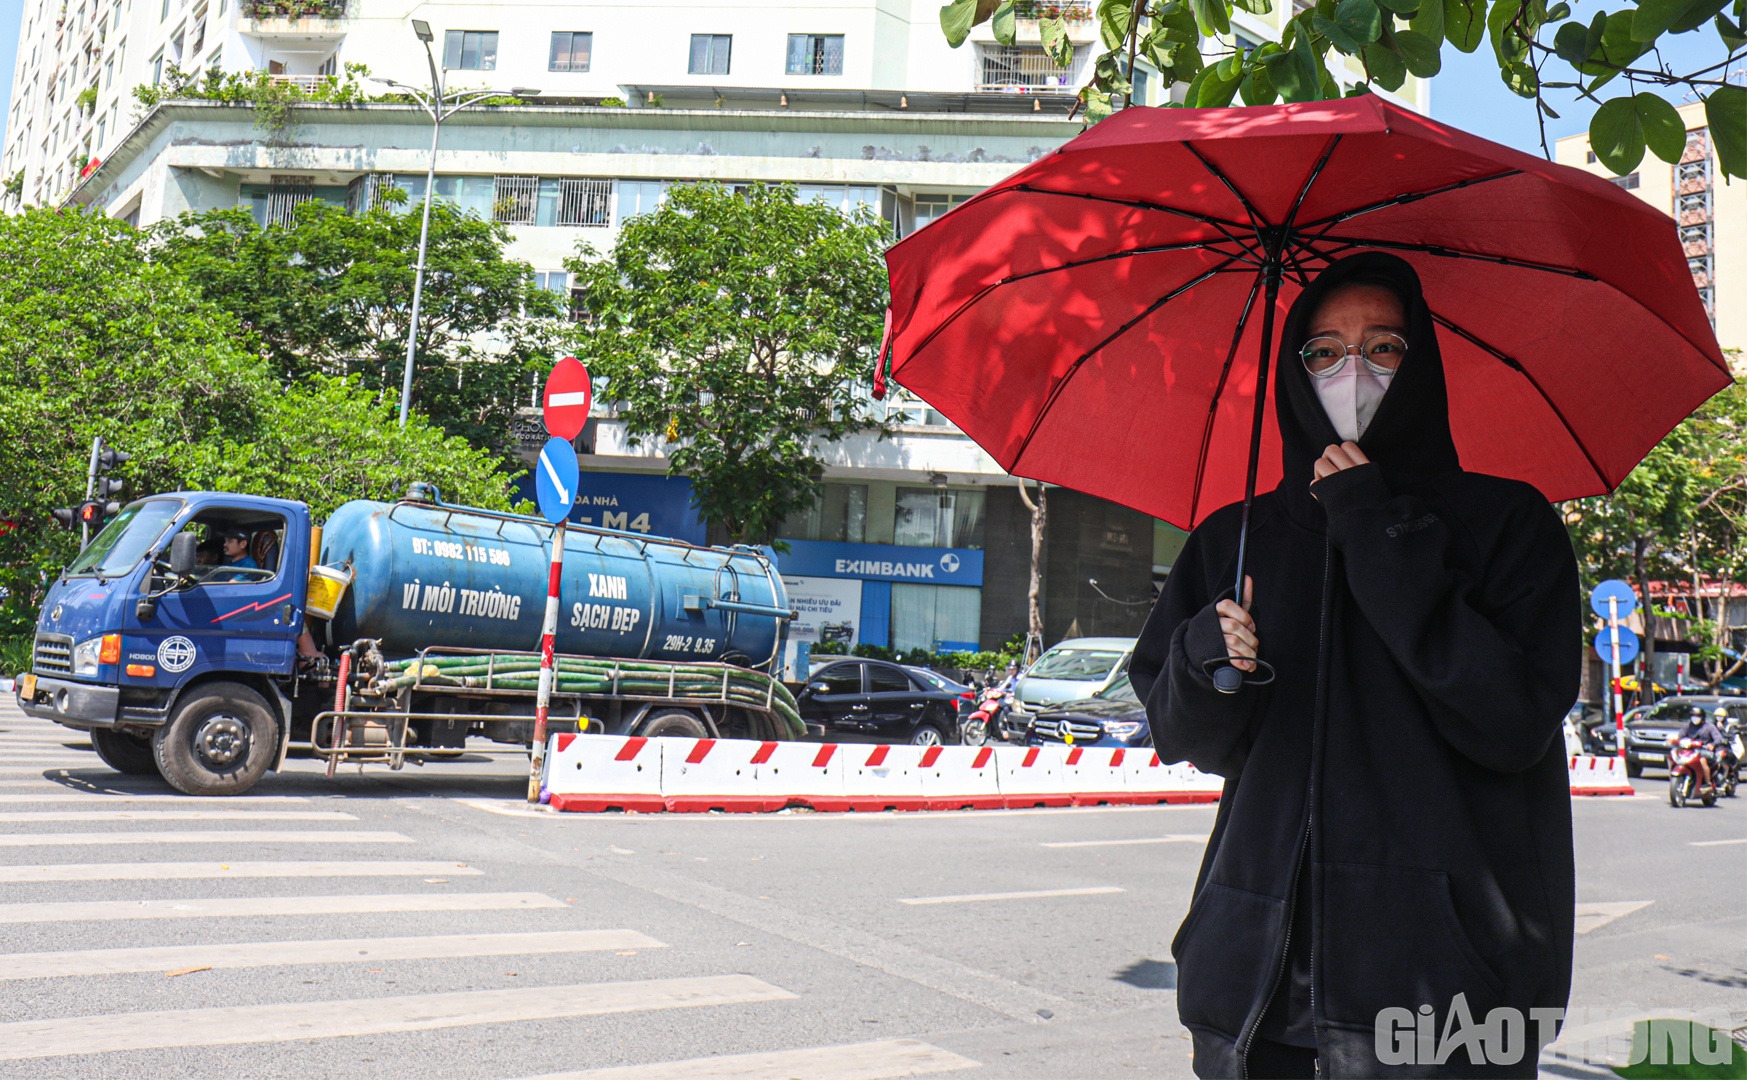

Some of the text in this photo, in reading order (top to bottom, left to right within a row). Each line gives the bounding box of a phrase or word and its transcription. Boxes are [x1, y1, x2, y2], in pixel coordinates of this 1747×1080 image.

[574, 492, 619, 507] ÒA NHÀ
[602, 510, 651, 534] M4
[434, 540, 464, 560] 0982
[465, 545, 488, 564] 115
[835, 559, 935, 578] EXIMBANK
[587, 572, 628, 600] XANH
[402, 578, 522, 621] VÌ MÔI TRƯỜNG
[570, 601, 640, 636] SẠCH ĐẸP
